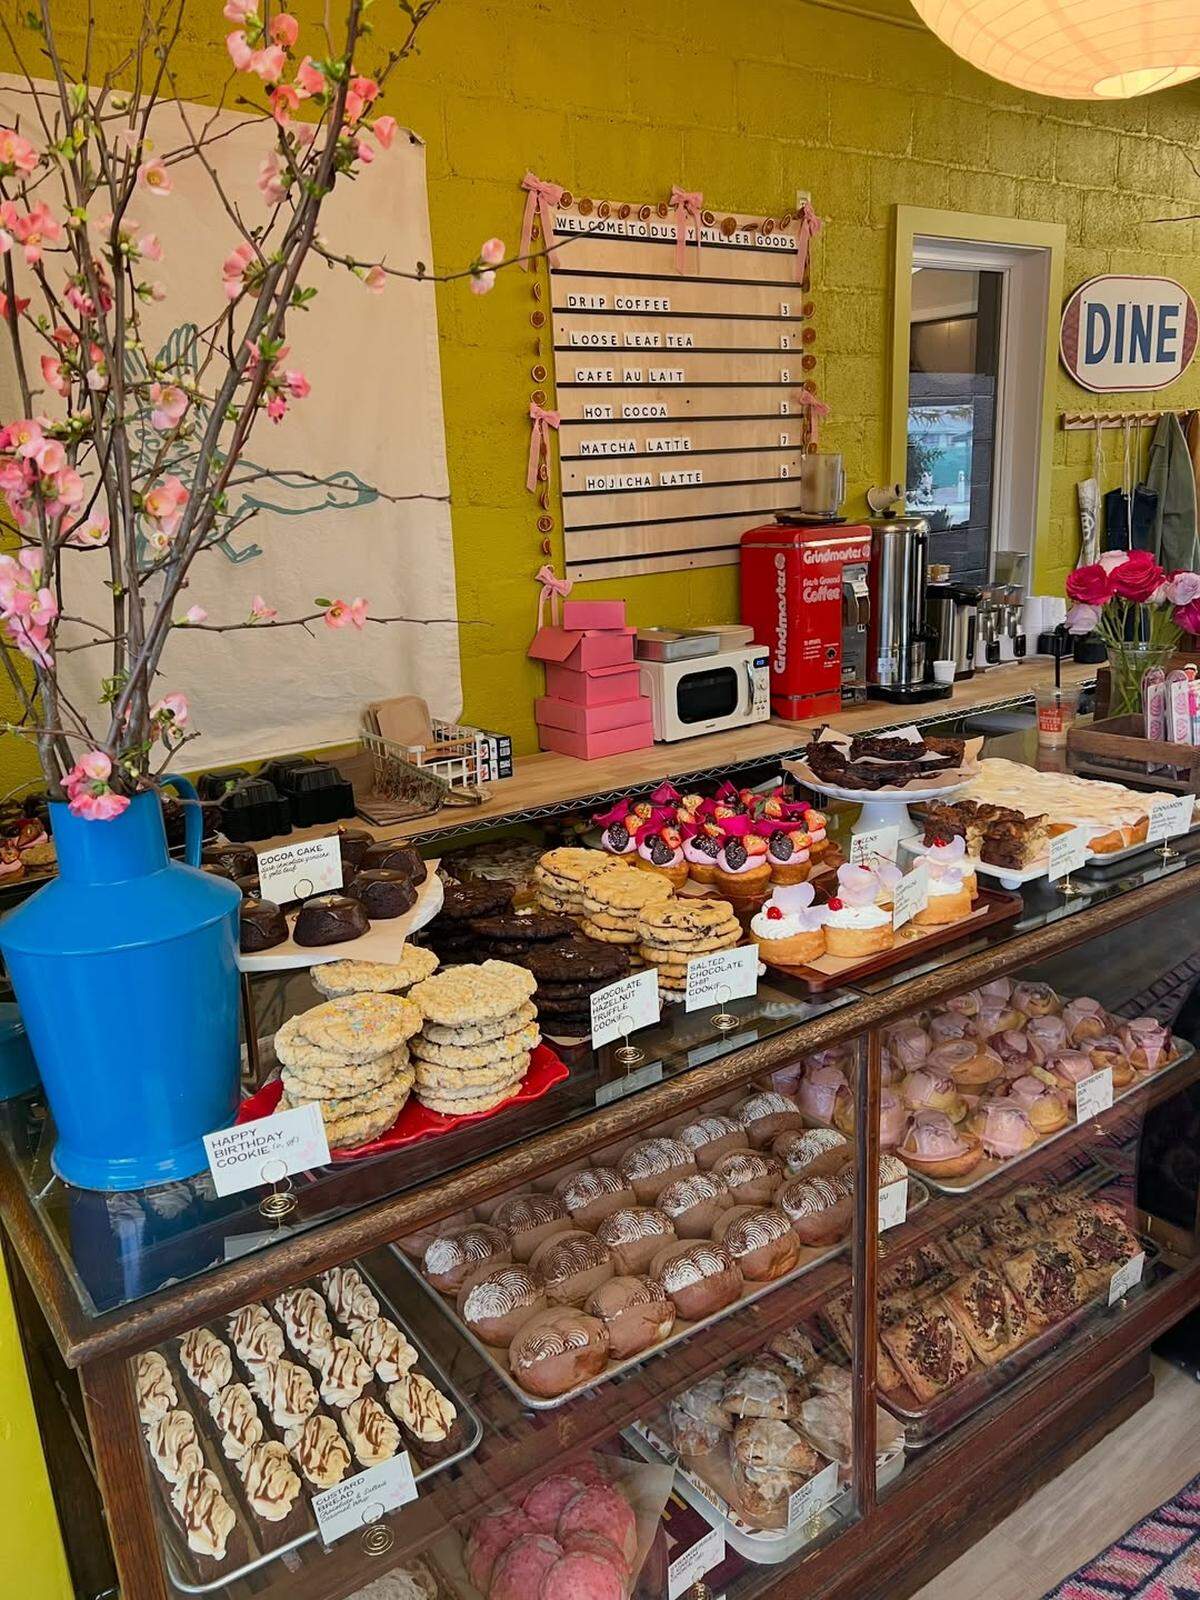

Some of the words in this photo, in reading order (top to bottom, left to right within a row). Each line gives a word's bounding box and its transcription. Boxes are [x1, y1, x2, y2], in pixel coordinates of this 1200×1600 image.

[556, 217, 624, 234] WELCOME
[629, 224, 647, 236] TO
[651, 226, 694, 239] DUSY
[700, 230, 750, 244] MILLER
[756, 236, 795, 248] GOODS
[568, 296, 606, 308] DRIP
[616, 298, 669, 311] COFFEE
[783, 305, 788, 315] 3
[571, 334, 617, 346] LOOSE
[625, 335, 659, 346] LEAF
[667, 336, 693, 347] TEA
[783, 338, 788, 348] 3
[1084, 302, 1180, 365] DINE
[577, 371, 613, 382] CAFE
[625, 372, 641, 382] AU
[650, 371, 683, 382] LAIT
[585, 407, 612, 418] HOT
[623, 406, 667, 417] COCOA
[783, 404, 788, 413] 3
[581, 442, 636, 454] MATCHA
[648, 440, 690, 451] LATTE
[782, 435, 787, 445] 7
[587, 476, 651, 489] HOJICHA
[661, 472, 701, 485] LATTE
[782, 467, 787, 477] 8
[803, 546, 862, 564] Grindmaster
[803, 585, 841, 603] Coffee
[774, 569, 787, 674] Grindmaster
[260, 851, 294, 866] COCOA
[296, 844, 324, 856] CAKE
[689, 960, 744, 981] CHOCOLATE
[690, 956, 726, 972] SALTED
[592, 979, 642, 1006] CHOCOLATE
[689, 977, 710, 989] CHIP
[592, 990, 636, 1015] HAZELNUT
[592, 1002, 629, 1025] TRUFFLE
[212, 1128, 257, 1150] HAPPY
[214, 1130, 284, 1159] BIRTHDAY
[216, 1145, 271, 1169] COOKIE
[316, 1476, 366, 1506] CUSTARD
[317, 1490, 354, 1513] BREAD
